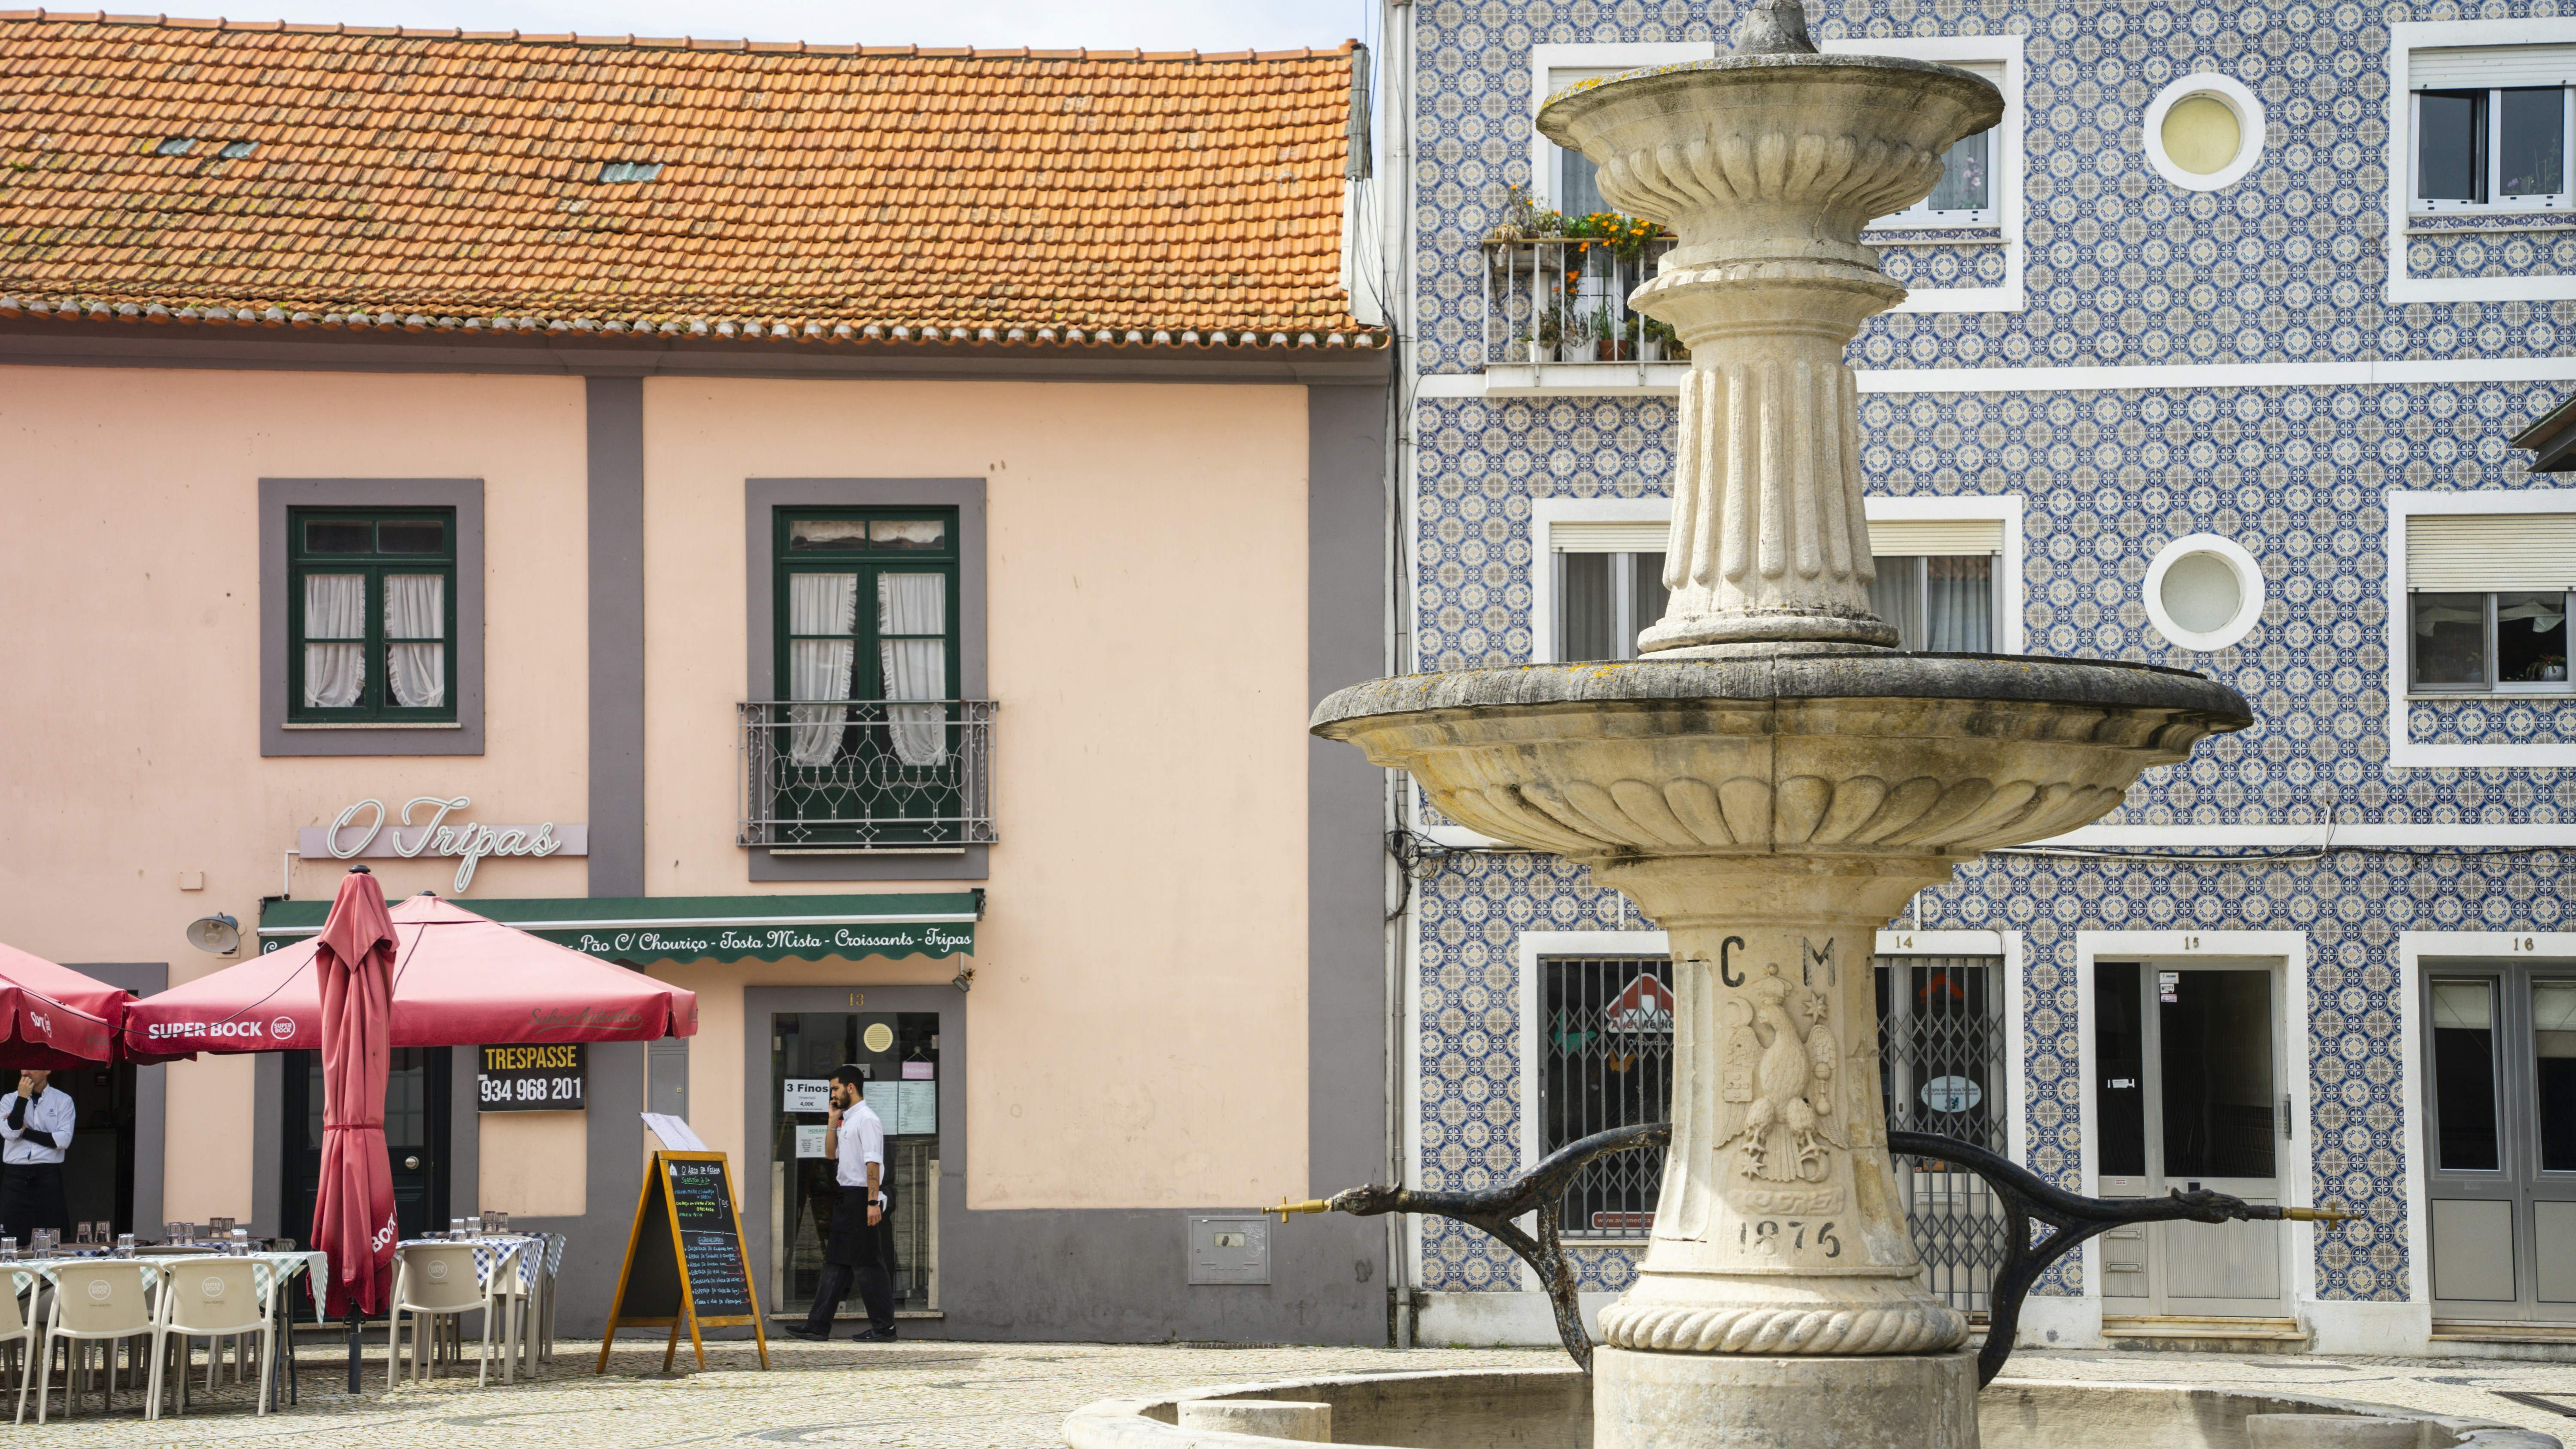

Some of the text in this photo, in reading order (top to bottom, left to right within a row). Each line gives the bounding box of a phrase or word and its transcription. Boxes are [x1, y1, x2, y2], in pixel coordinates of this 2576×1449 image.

[327, 796, 561, 893] O Tripas
[578, 935, 610, 952] Pão
[639, 933, 708, 952] Chouriço
[720, 931, 763, 949] Tosta
[767, 930, 822, 948] Mista
[835, 929, 914, 947] Croissants
[924, 927, 972, 952] Tripas
[1896, 935, 1913, 948] 14
[2185, 936, 2199, 949] 15
[2514, 937, 2533, 951] 16
[1721, 936, 1835, 987] C M
[850, 993, 863, 1006] 13
[529, 1009, 574, 1025] Sabor
[149, 1021, 263, 1039] SUPER BOCK
[486, 1046, 576, 1069] TRESPASSE
[481, 1077, 580, 1101] 934 968 201
[787, 1084, 829, 1093] 3 Finos
[372, 1212, 396, 1253] BOCK
[1740, 1221, 1841, 1258] 1876
